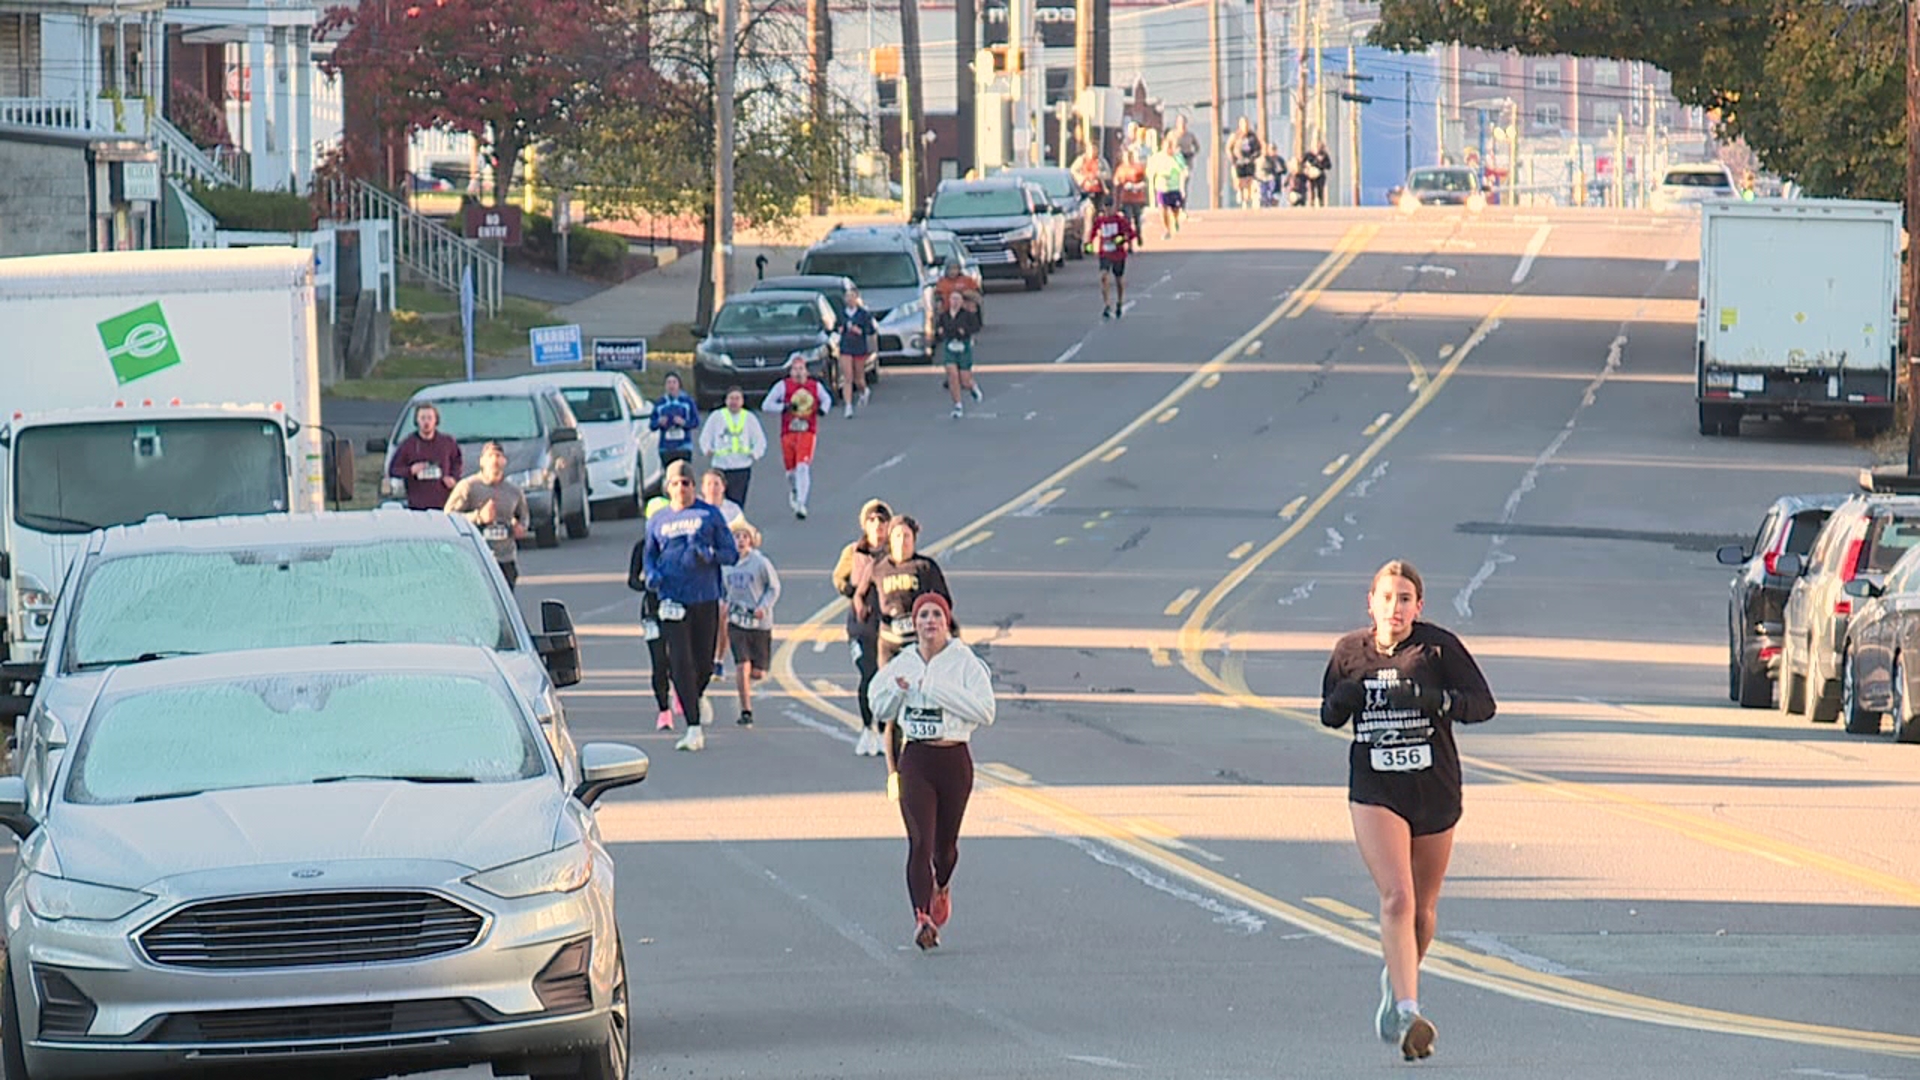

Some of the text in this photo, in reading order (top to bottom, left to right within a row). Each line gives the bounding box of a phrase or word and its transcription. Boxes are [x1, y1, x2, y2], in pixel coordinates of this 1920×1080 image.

[485, 213, 500, 225] NO
[477, 226, 508, 238] ENTRY
[535, 328, 577, 345] HARRIS
[1362, 709, 1421, 720] CROSS COUNTRY
[910, 722, 937, 737] 339
[1382, 748, 1421, 767] 356
